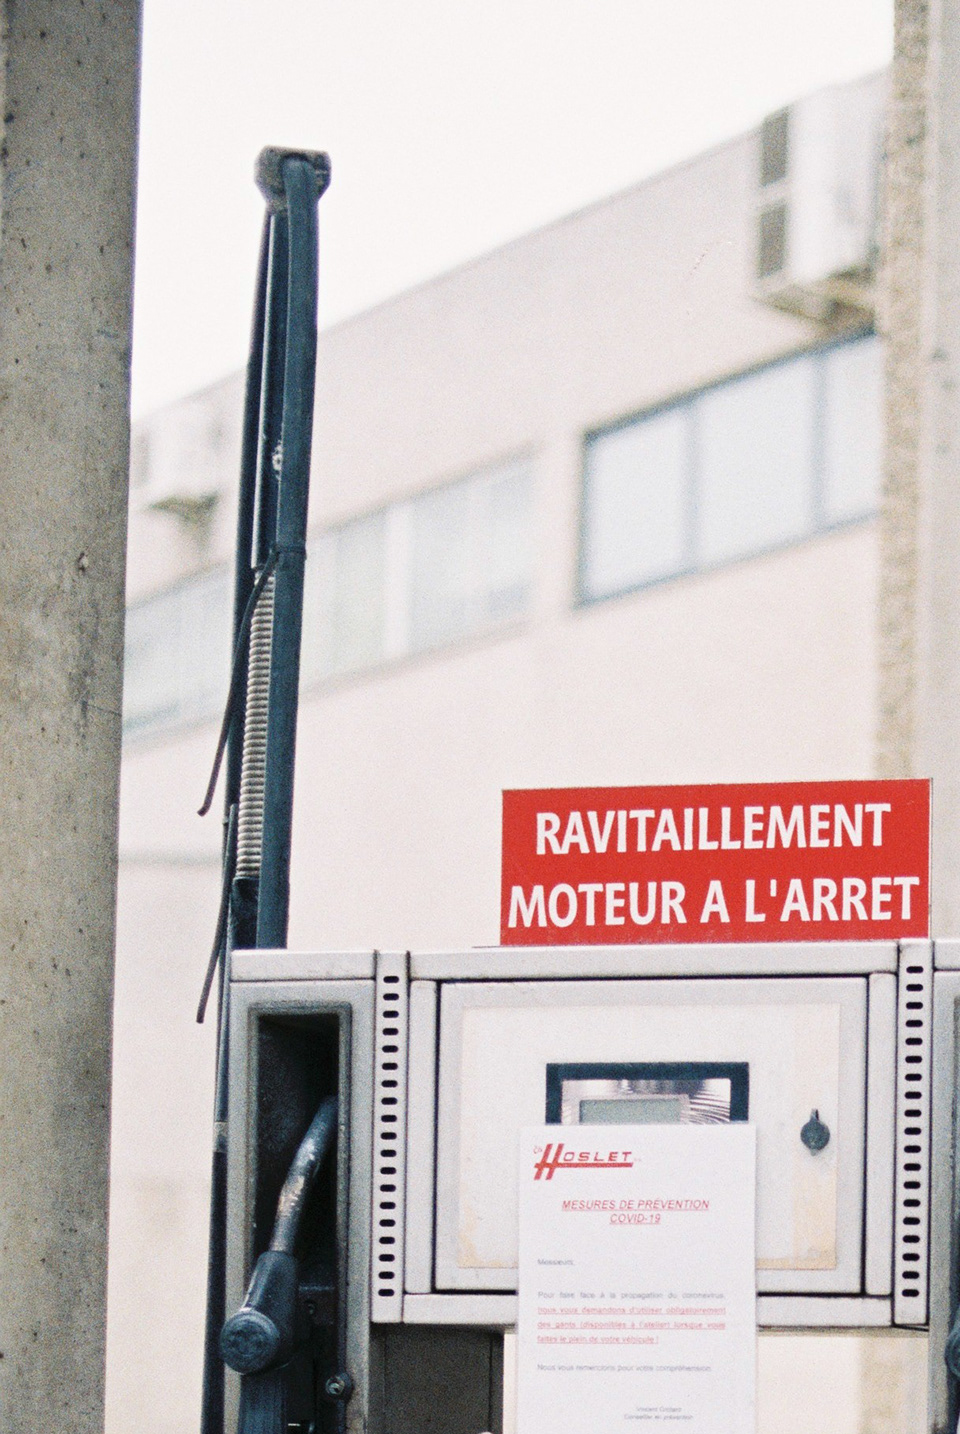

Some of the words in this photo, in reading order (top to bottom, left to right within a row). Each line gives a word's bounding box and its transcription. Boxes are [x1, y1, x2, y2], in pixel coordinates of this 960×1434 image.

[536, 803, 891, 854] RAVITAILLEMENT
[508, 881, 687, 928] MOTEUR
[700, 879, 730, 923] A
[745, 876, 920, 923] L'ARRET
[533, 1143, 633, 1180] HOSLET
[562, 1200, 616, 1210] MESURES
[619, 1200, 635, 1210] DE
[637, 1197, 710, 1210] PRÉVENTION
[609, 1213, 661, 1224] COVID-19
[537, 1291, 555, 1299] Pour
